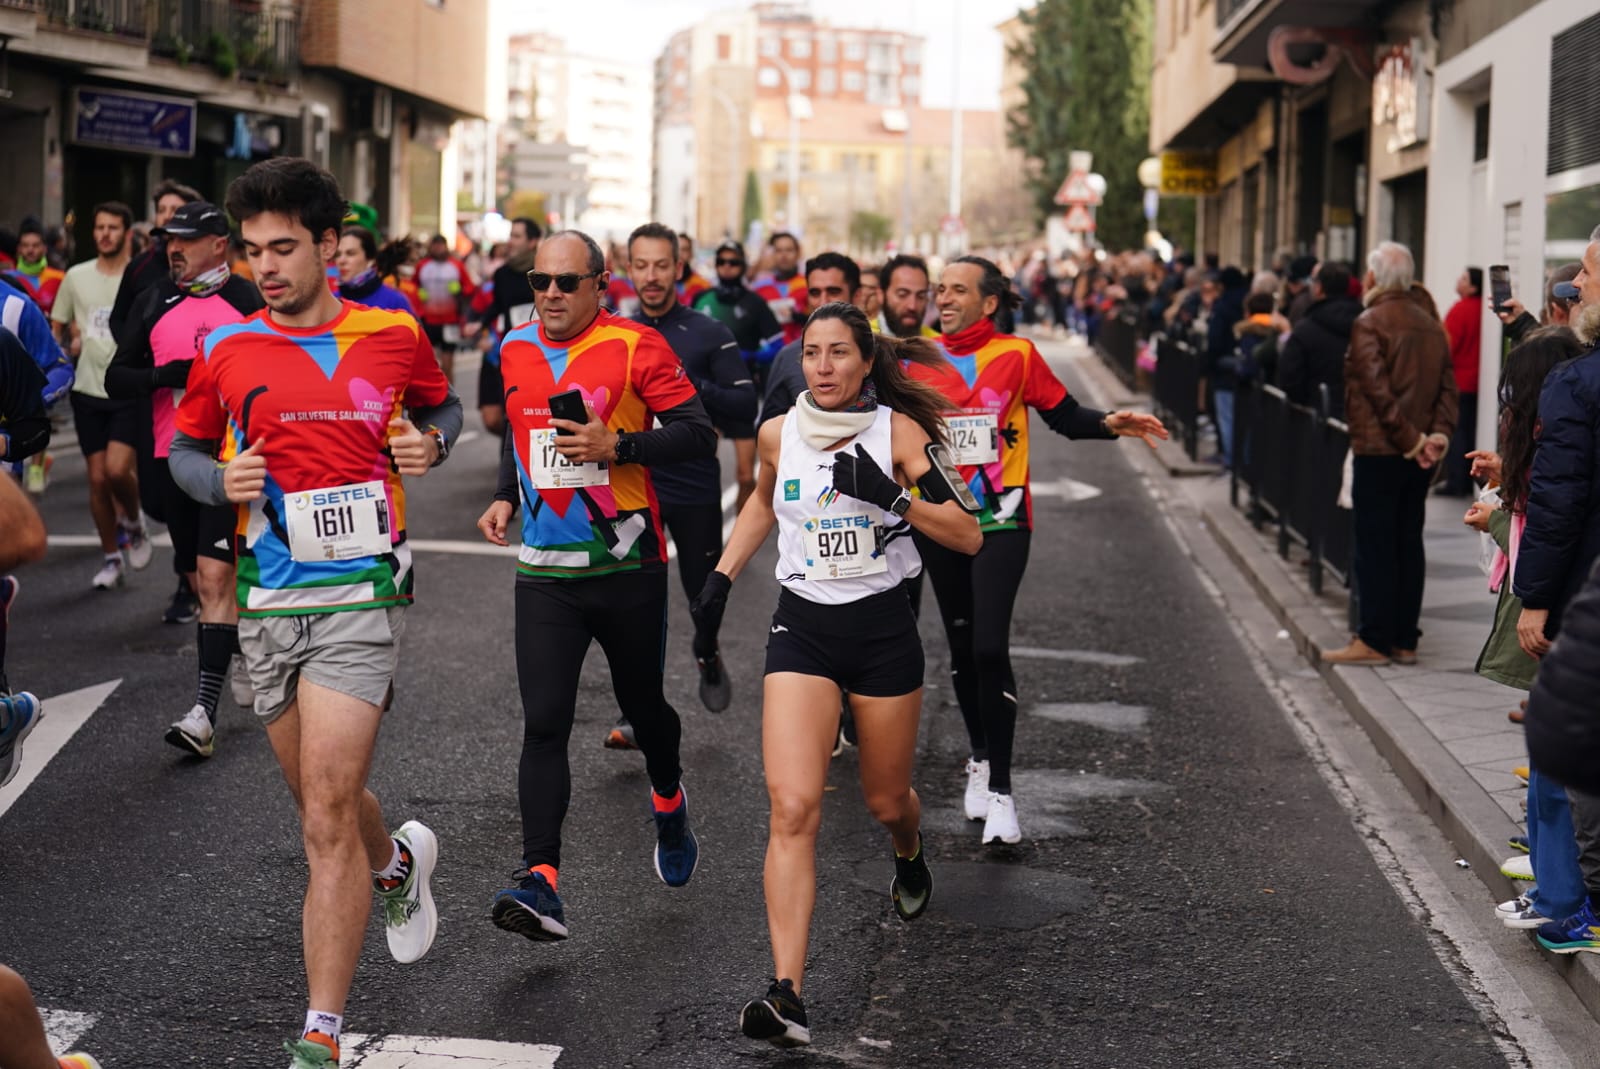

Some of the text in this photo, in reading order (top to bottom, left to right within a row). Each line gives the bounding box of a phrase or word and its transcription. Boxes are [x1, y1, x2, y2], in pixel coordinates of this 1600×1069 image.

[280, 410, 381, 423] SAN SILVESTRE SALMANTIN
[950, 419, 990, 428] SETEL
[313, 487, 376, 506] SETEL
[313, 505, 355, 538] 1611
[821, 515, 875, 529] SETEL
[818, 530, 858, 558] 920
